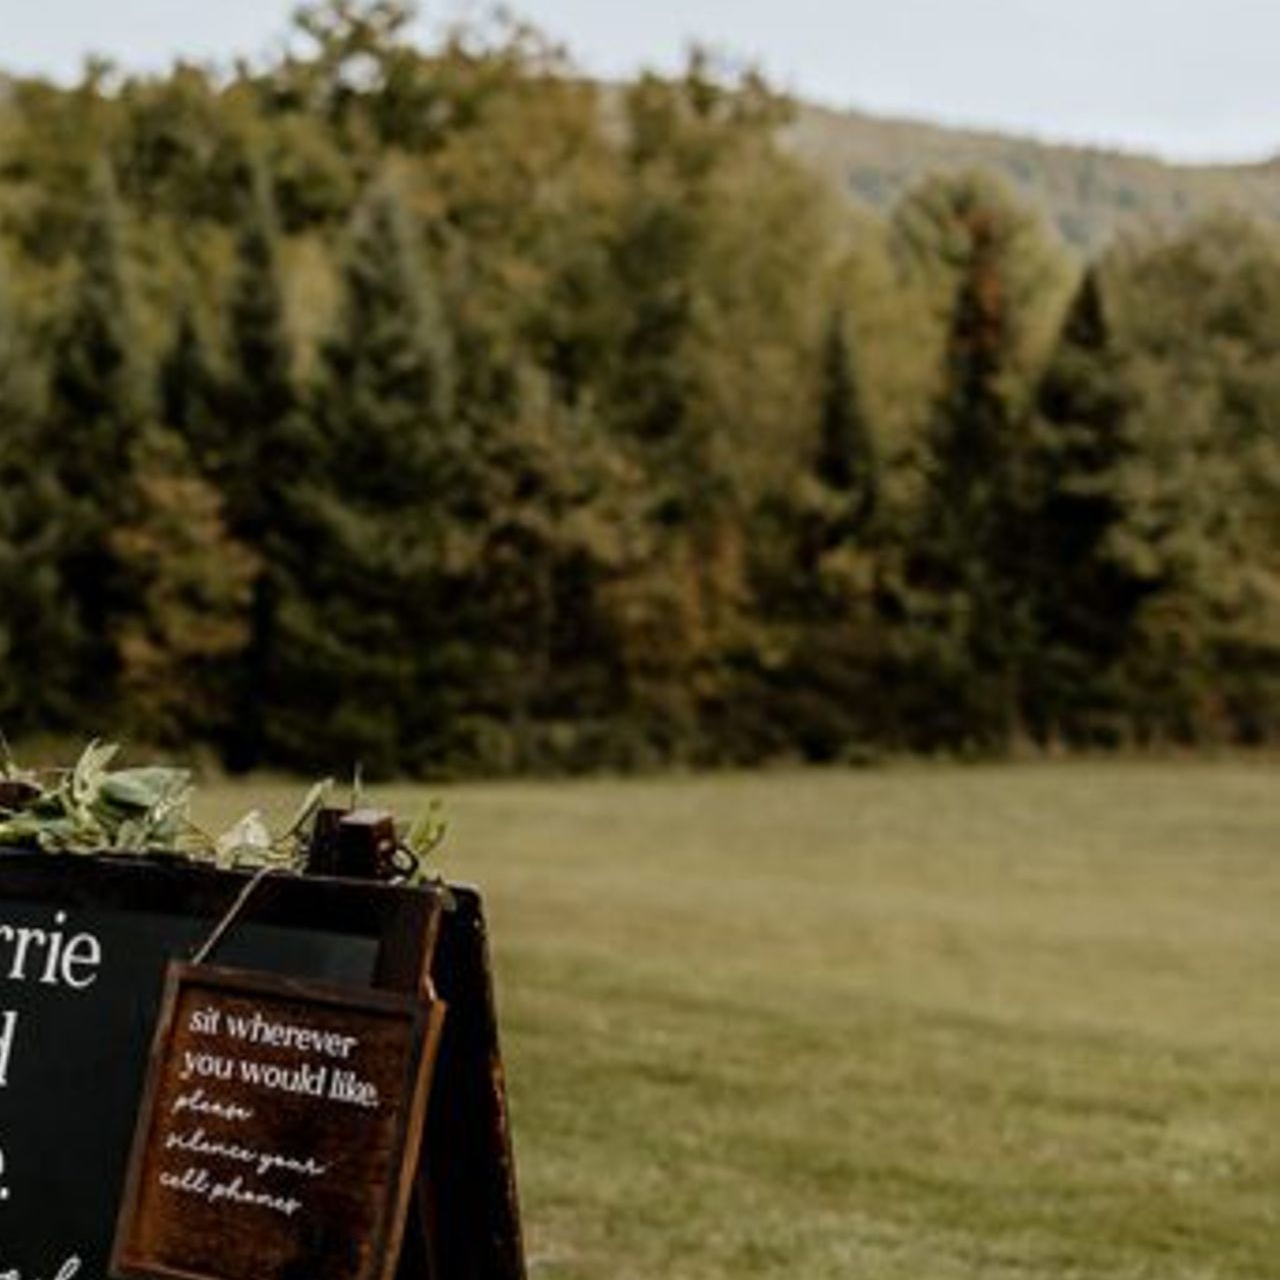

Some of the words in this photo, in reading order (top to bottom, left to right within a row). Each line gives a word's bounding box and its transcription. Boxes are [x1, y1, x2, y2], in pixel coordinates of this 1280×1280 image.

[189, 1007, 220, 1035] sit
[227, 1013, 358, 1059] wherever
[171, 1088, 254, 1121] please
[180, 1052, 232, 1080] you
[241, 1063, 325, 1095] would
[328, 1069, 379, 1108] like.
[166, 1128, 257, 1161] silence
[256, 1153, 328, 1176] your
[159, 1168, 210, 1194] cell
[208, 1175, 302, 1217] phones
